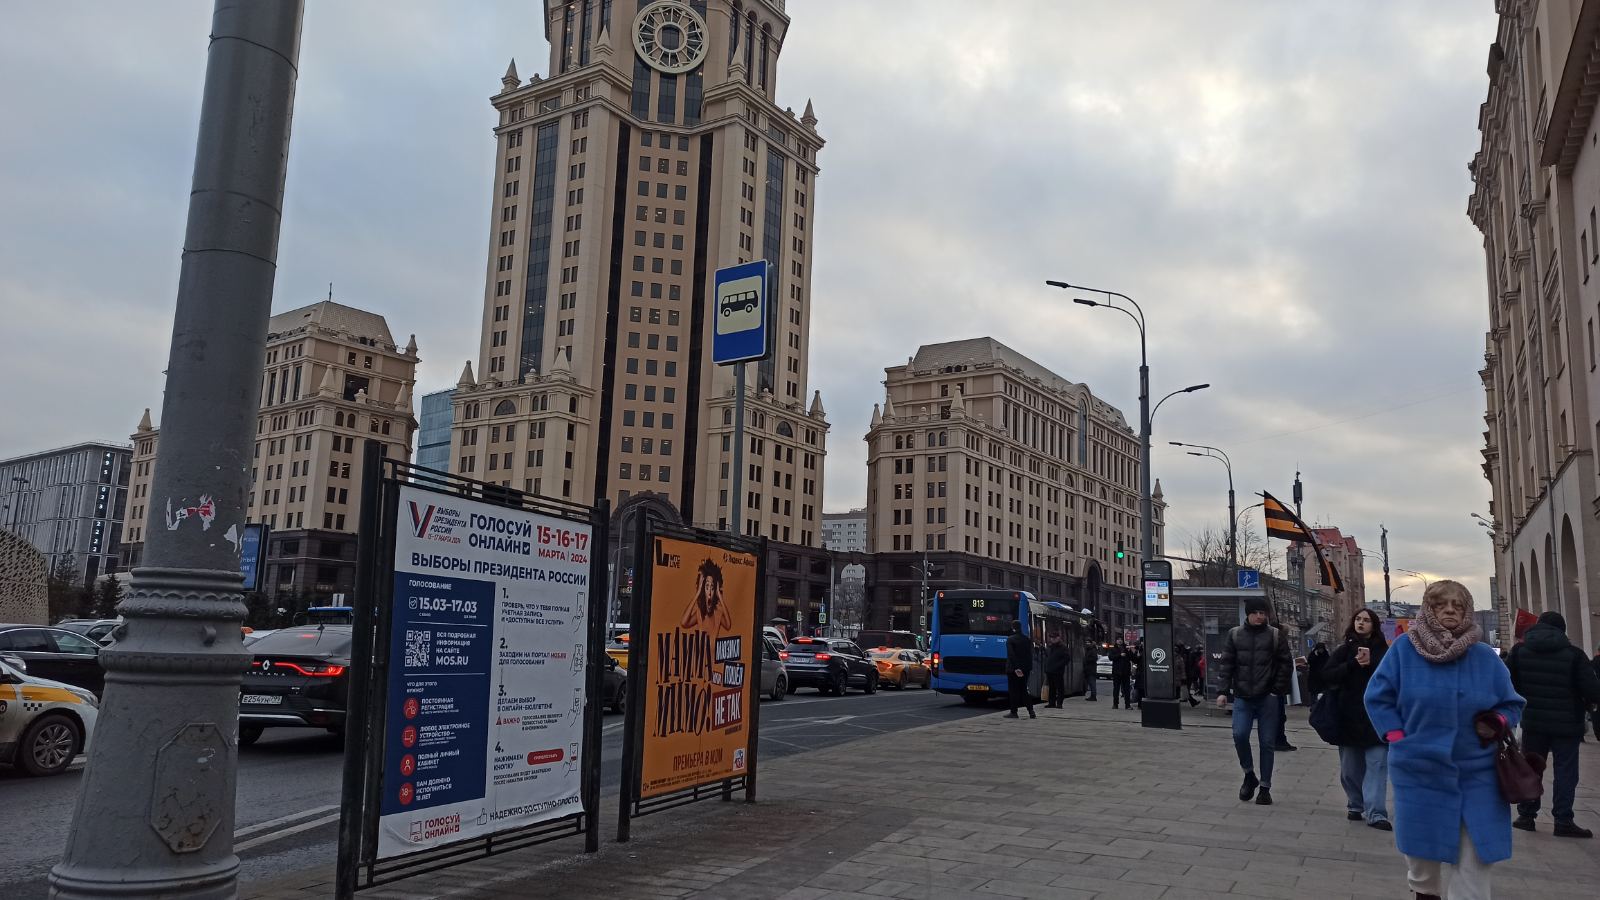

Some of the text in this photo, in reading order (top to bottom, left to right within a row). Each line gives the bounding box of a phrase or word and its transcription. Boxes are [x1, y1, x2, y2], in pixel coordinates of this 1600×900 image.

[437, 507, 460, 517] ВЫБОРЫ
[434, 516, 467, 528] ПРЕЗИДЕНТА
[470, 513, 532, 538] ГОЛОСУЙ
[430, 525, 452, 534] РОССИИ
[536, 524, 588, 550] 15-16-17
[468, 533, 521, 554] ОНЛАЙН
[538, 548, 588, 564] МАРТА 2024
[412, 552, 586, 586] ВЫБОРЫ ПРЕЗИДЕНТА РОССИИ
[408, 580, 452, 590] ГОЛОСОВАНИЕ
[502, 588, 509, 599] 1.
[502, 602, 525, 610] ПРОВЕРЬ,
[972, 600, 985, 608] 913
[524, 610, 543, 618] ЗАПИСЬ
[500, 638, 508, 650] 2.
[436, 656, 469, 666] MOS.RU
[498, 684, 507, 696] 3.
[715, 692, 740, 726] НЕ ТАК
[420, 730, 451, 738] УСТРОЙСТВО
[495, 741, 504, 753] 4.
[418, 752, 439, 760] ПОЛНЫЙ
[494, 754, 524, 763] НАЖИМАЕМ
[673, 750, 704, 772] ПРЕМЬЕРА
[705, 752, 710, 766] В
[418, 759, 439, 767] КАБИНЕТ
[494, 763, 514, 771] КНОПКУ
[416, 784, 452, 794] ИСПОЛНИТЬСЯ
[424, 812, 461, 828] ГОЛОСУЙ
[424, 824, 454, 840] ОНЛАЙН
